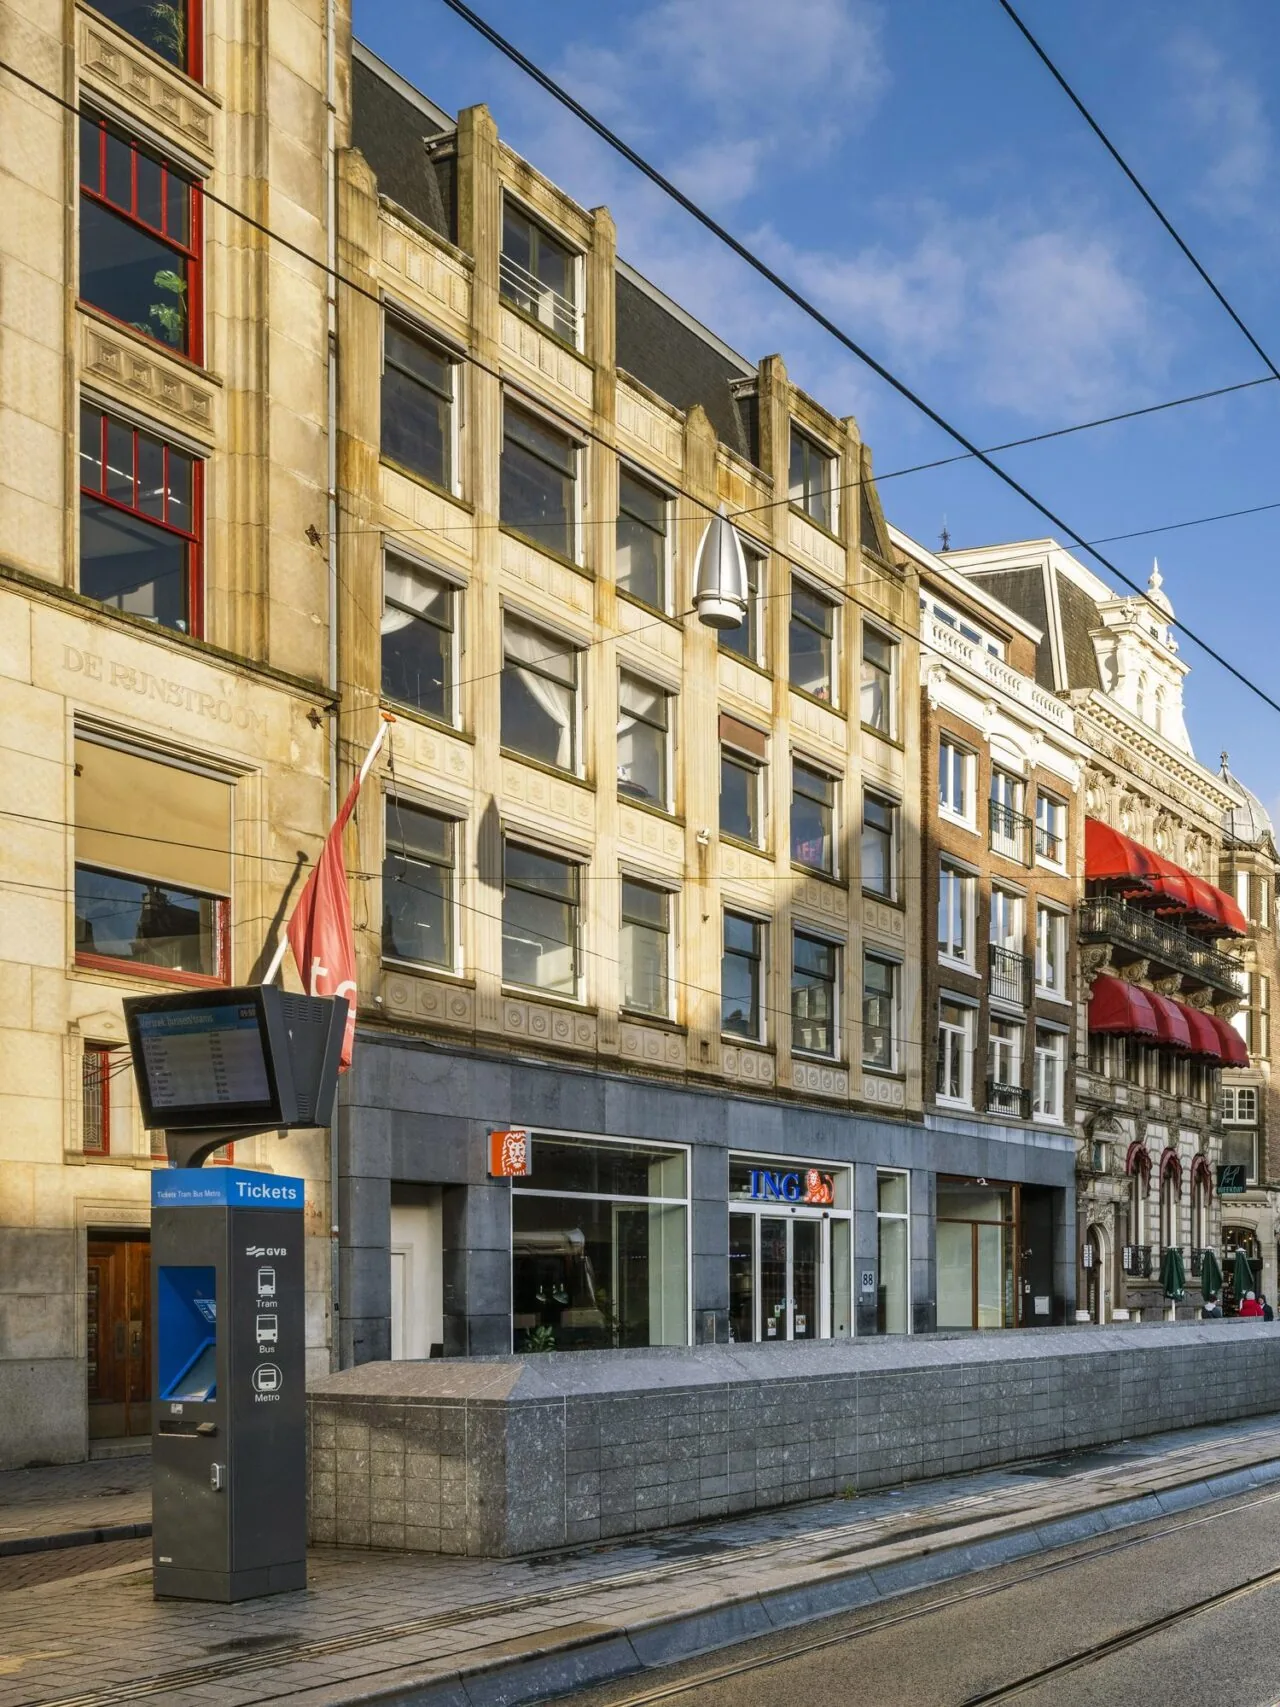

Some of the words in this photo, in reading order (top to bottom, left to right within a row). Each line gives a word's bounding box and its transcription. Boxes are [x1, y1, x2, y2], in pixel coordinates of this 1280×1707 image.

[61, 643, 103, 681] DE
[236, 1181, 297, 1200] Tickets
[749, 1168, 800, 1203] ING
[266, 1247, 287, 1256] GVB
[862, 1273, 874, 1286] 88
[256, 1299, 278, 1308] Tram
[259, 1345, 275, 1353] Bus
[254, 1393, 281, 1402] Metro
